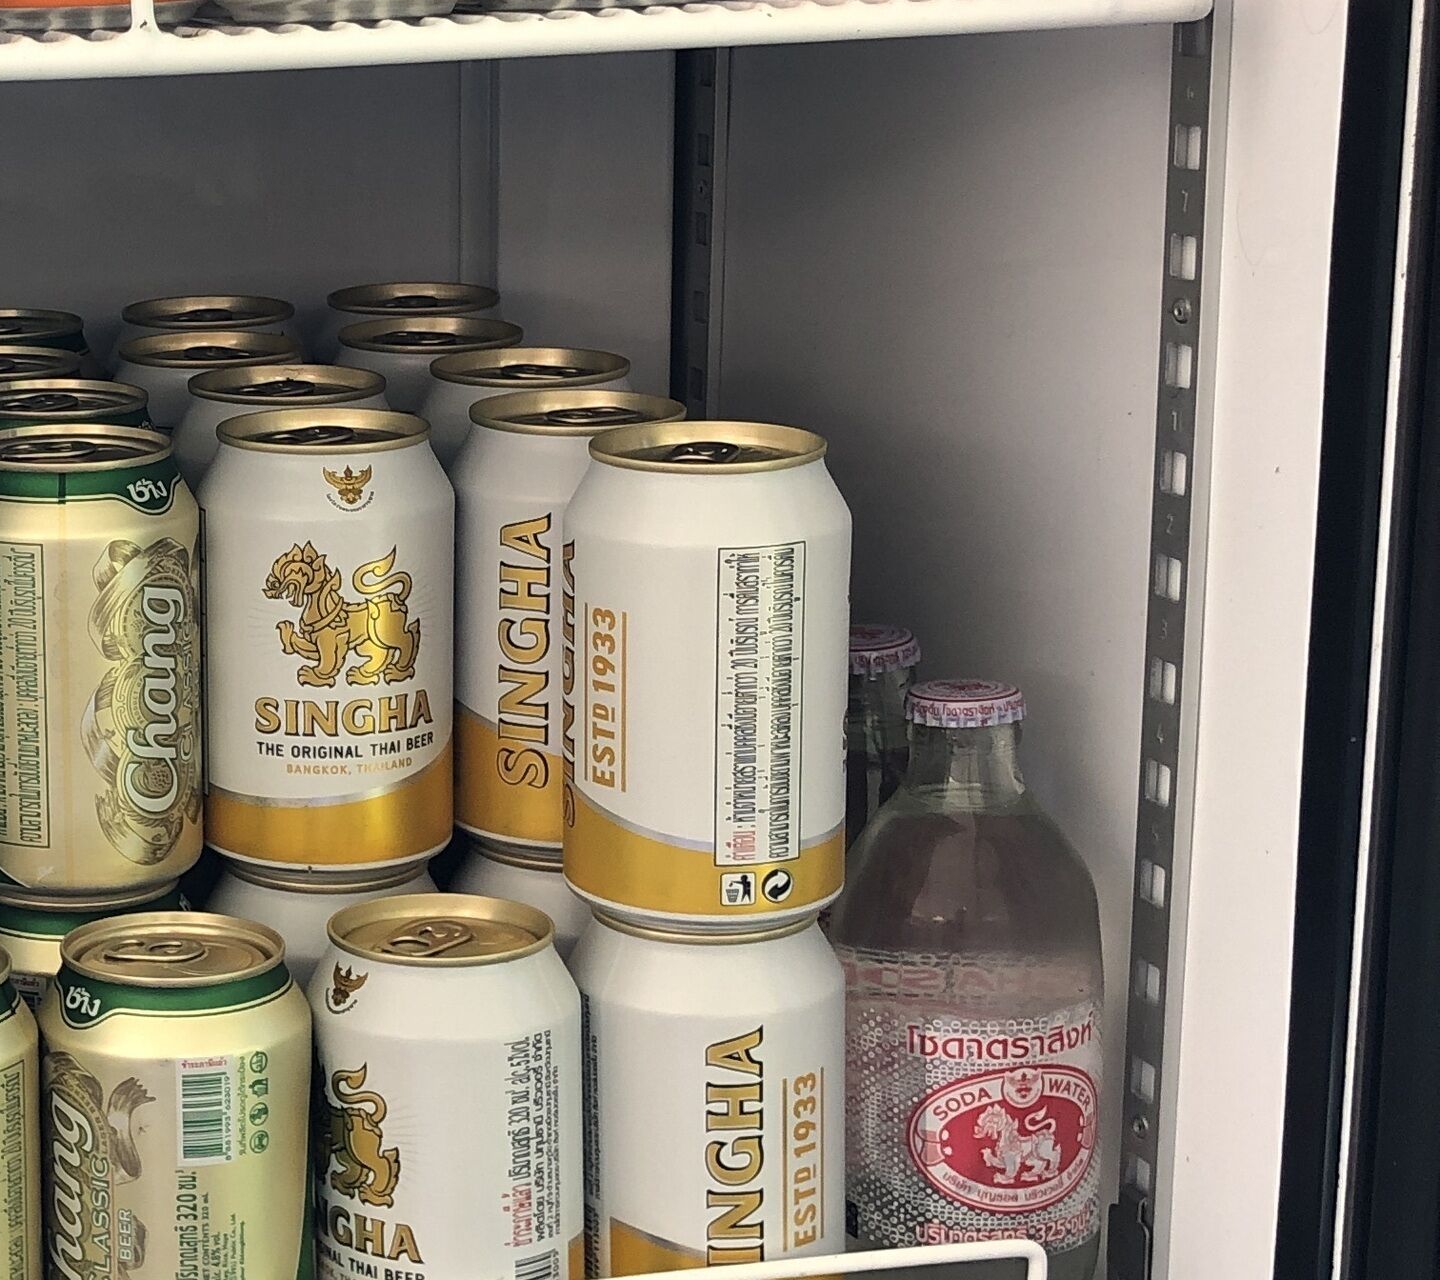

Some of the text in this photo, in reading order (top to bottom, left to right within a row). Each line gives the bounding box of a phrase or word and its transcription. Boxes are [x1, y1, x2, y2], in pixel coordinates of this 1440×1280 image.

[126, 476, 168, 504] ช้าง
[768, 622, 791, 634] 20
[496, 511, 552, 789] SINGHA
[592, 606, 617, 695] 1933
[729, 659, 756, 670] 20
[124, 584, 184, 814] Chang
[255, 688, 433, 738] SINGHA
[256, 732, 434, 760] THE ORIGINAL THAI BEER
[286, 756, 413, 775] BANGKOK, THAILAND
[66, 986, 101, 1018] ช้าง
[907, 1011, 1094, 1060] โซดาตราสิงห์
[508, 1106, 530, 1126] 320
[794, 1070, 817, 1156] 1933
[933, 1078, 1092, 1121] SODA WATER
[176, 1194, 198, 1221] 320
[120, 1207, 133, 1264] BEER
[202, 1223, 211, 1265] CONTENTS
[317, 1210, 424, 1266] NGHA
[350, 1259, 379, 1279] THAI
